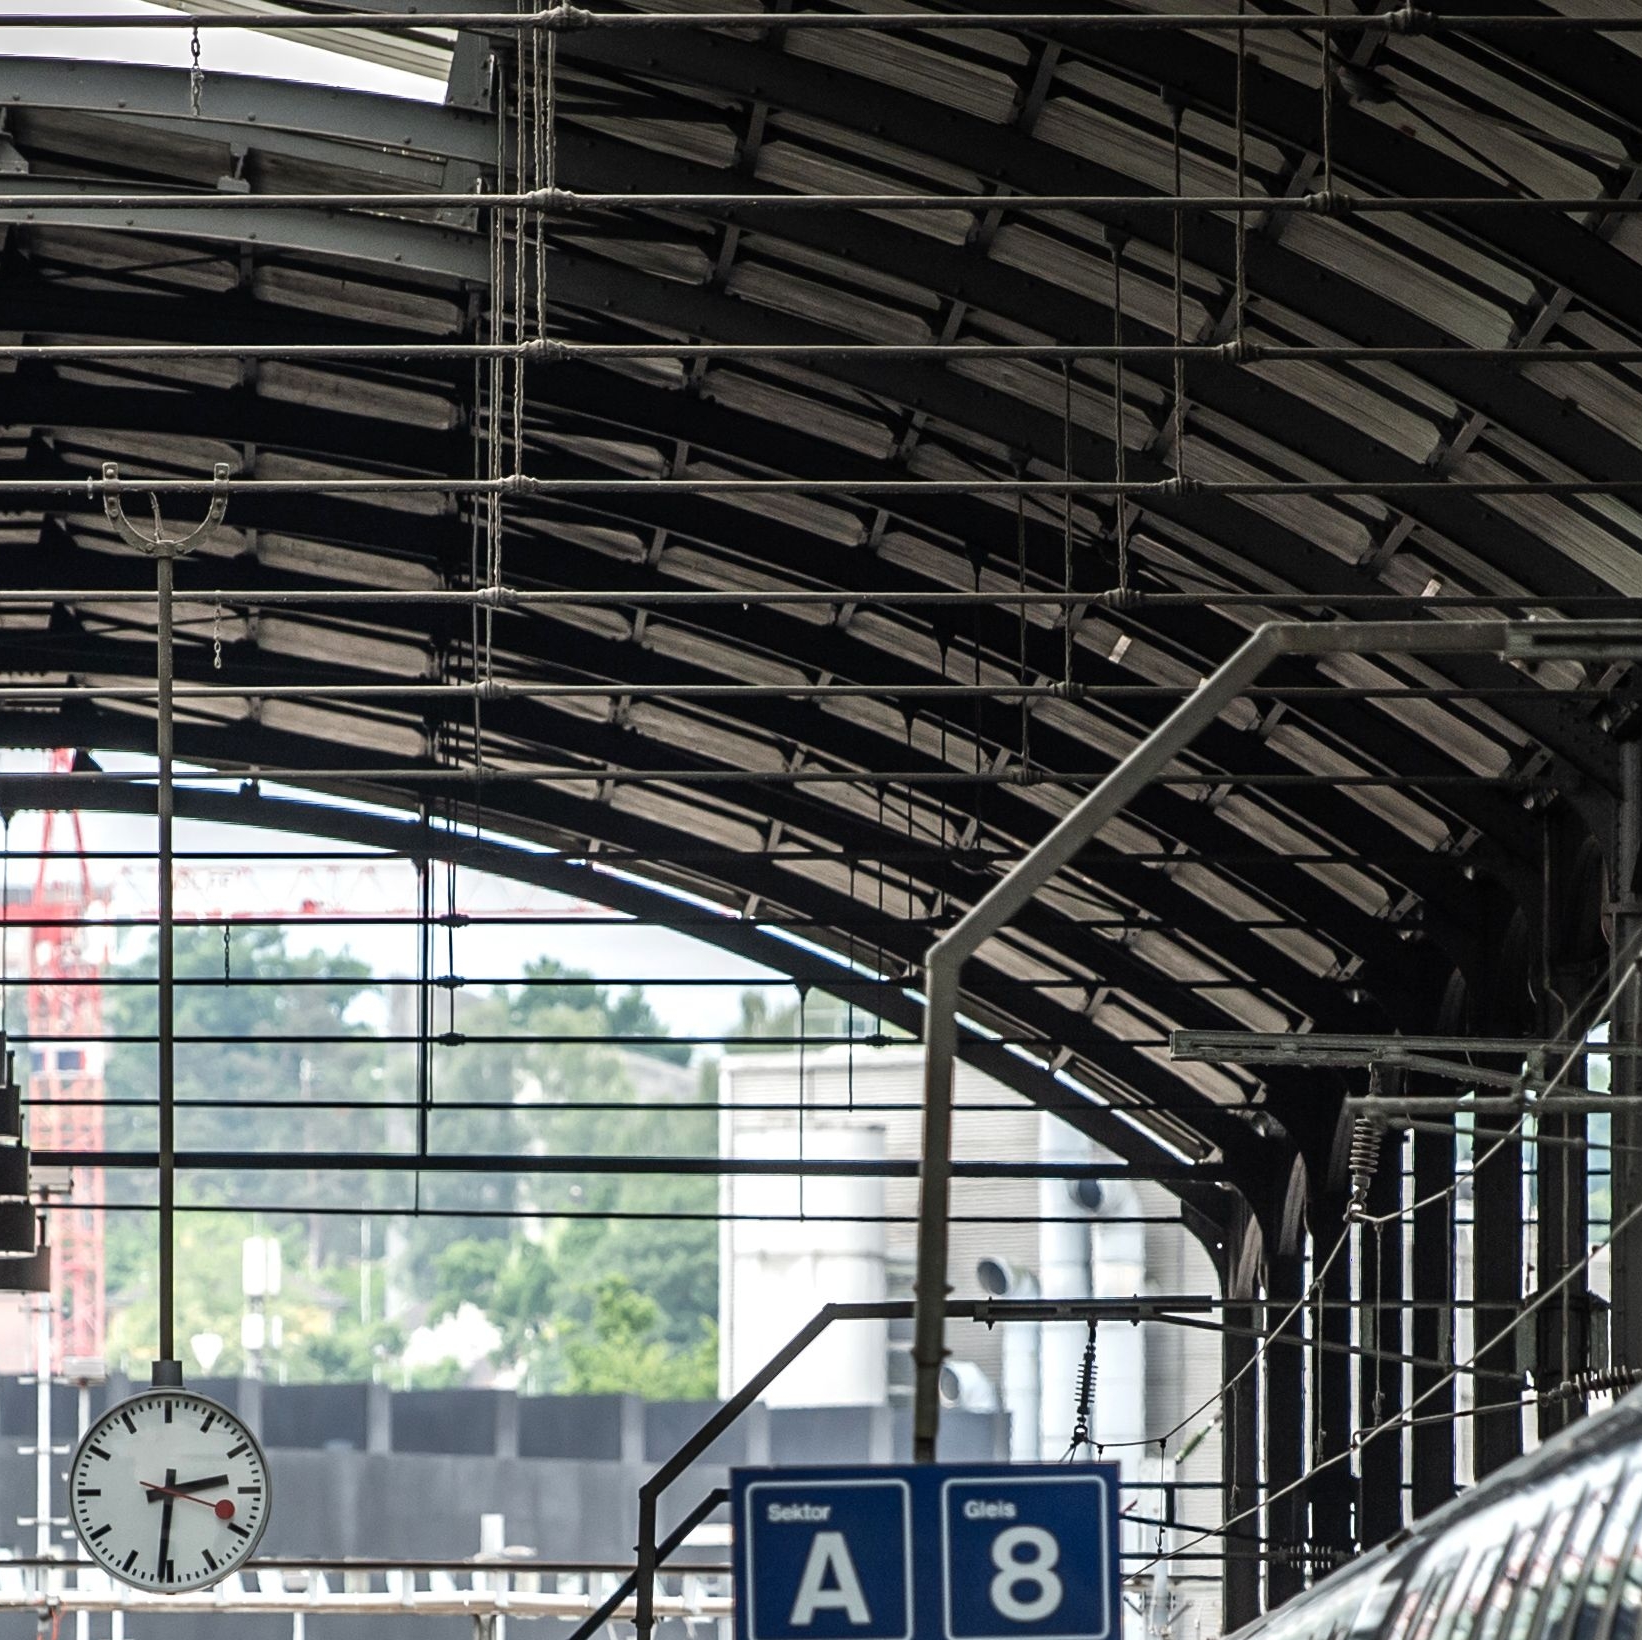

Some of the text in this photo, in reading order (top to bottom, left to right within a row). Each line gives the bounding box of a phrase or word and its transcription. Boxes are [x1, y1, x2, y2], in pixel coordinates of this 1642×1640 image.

[767, 1503, 831, 1522] Sektor
[964, 1500, 1017, 1520] Gleis
[789, 1531, 871, 1625] A
[989, 1525, 1063, 1622] 8
